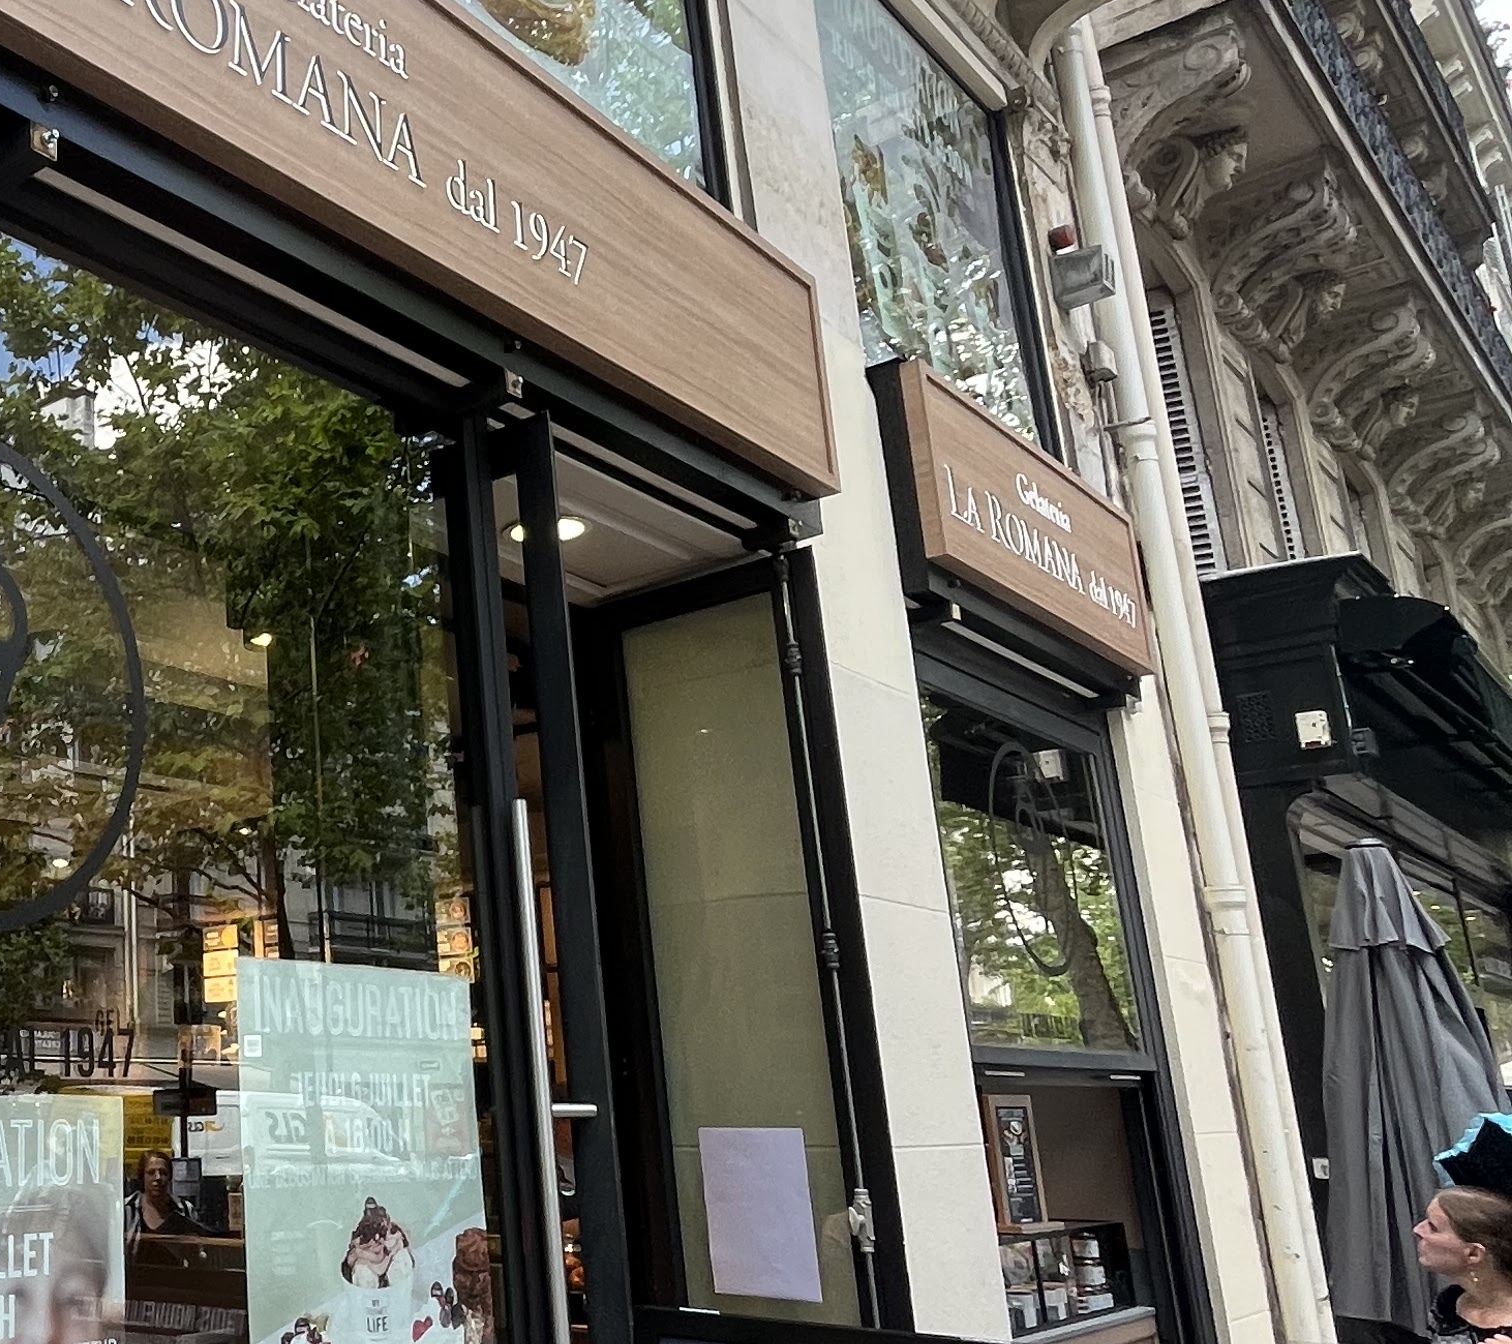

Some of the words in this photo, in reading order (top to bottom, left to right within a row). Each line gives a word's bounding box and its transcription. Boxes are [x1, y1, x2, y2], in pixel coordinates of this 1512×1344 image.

[445, 158, 501, 235] dal
[511, 199, 591, 286] 1947
[1014, 472, 1073, 534] Gelateria
[943, 463, 986, 537] LA
[984, 490, 1086, 593] ROMANA
[1088, 569, 1113, 612] dal
[1108, 587, 1137, 630] 1947
[253, 972, 460, 1042] INAUGURATION
[61, 1027, 136, 1078] 1947
[366, 1315, 389, 1334] LIFE
